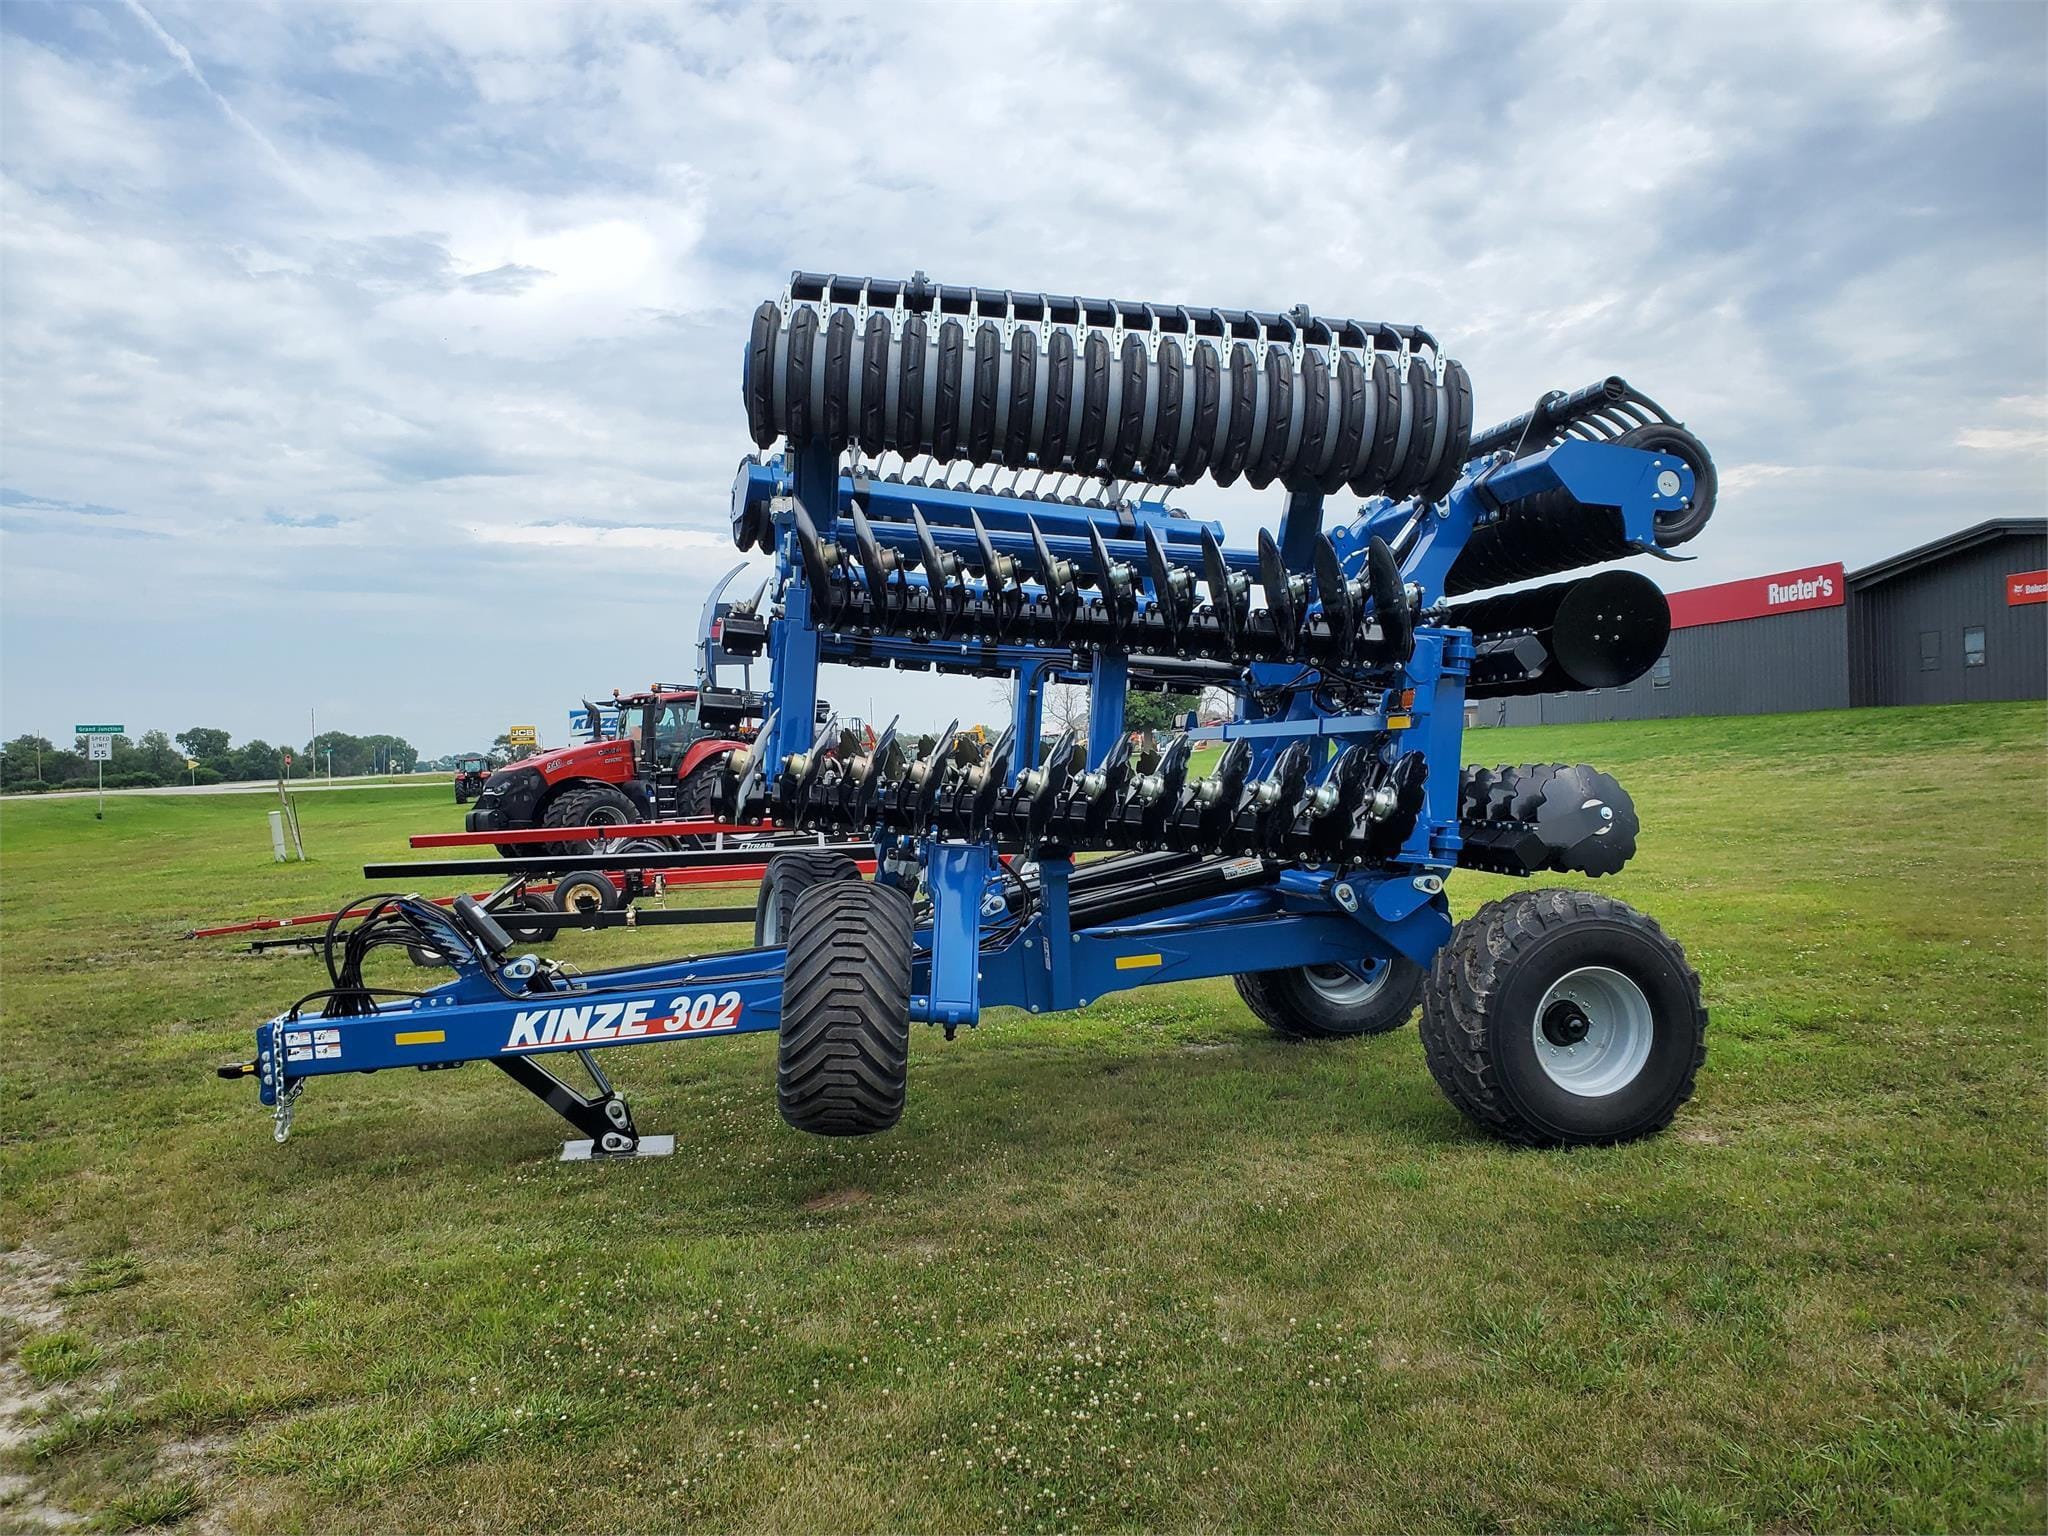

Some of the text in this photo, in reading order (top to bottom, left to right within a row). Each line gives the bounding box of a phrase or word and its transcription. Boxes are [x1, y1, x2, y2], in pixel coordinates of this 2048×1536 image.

[1768, 575, 1833, 605] Rueter's
[94, 750, 107, 758] 55
[506, 990, 742, 1047] KINZE 302
